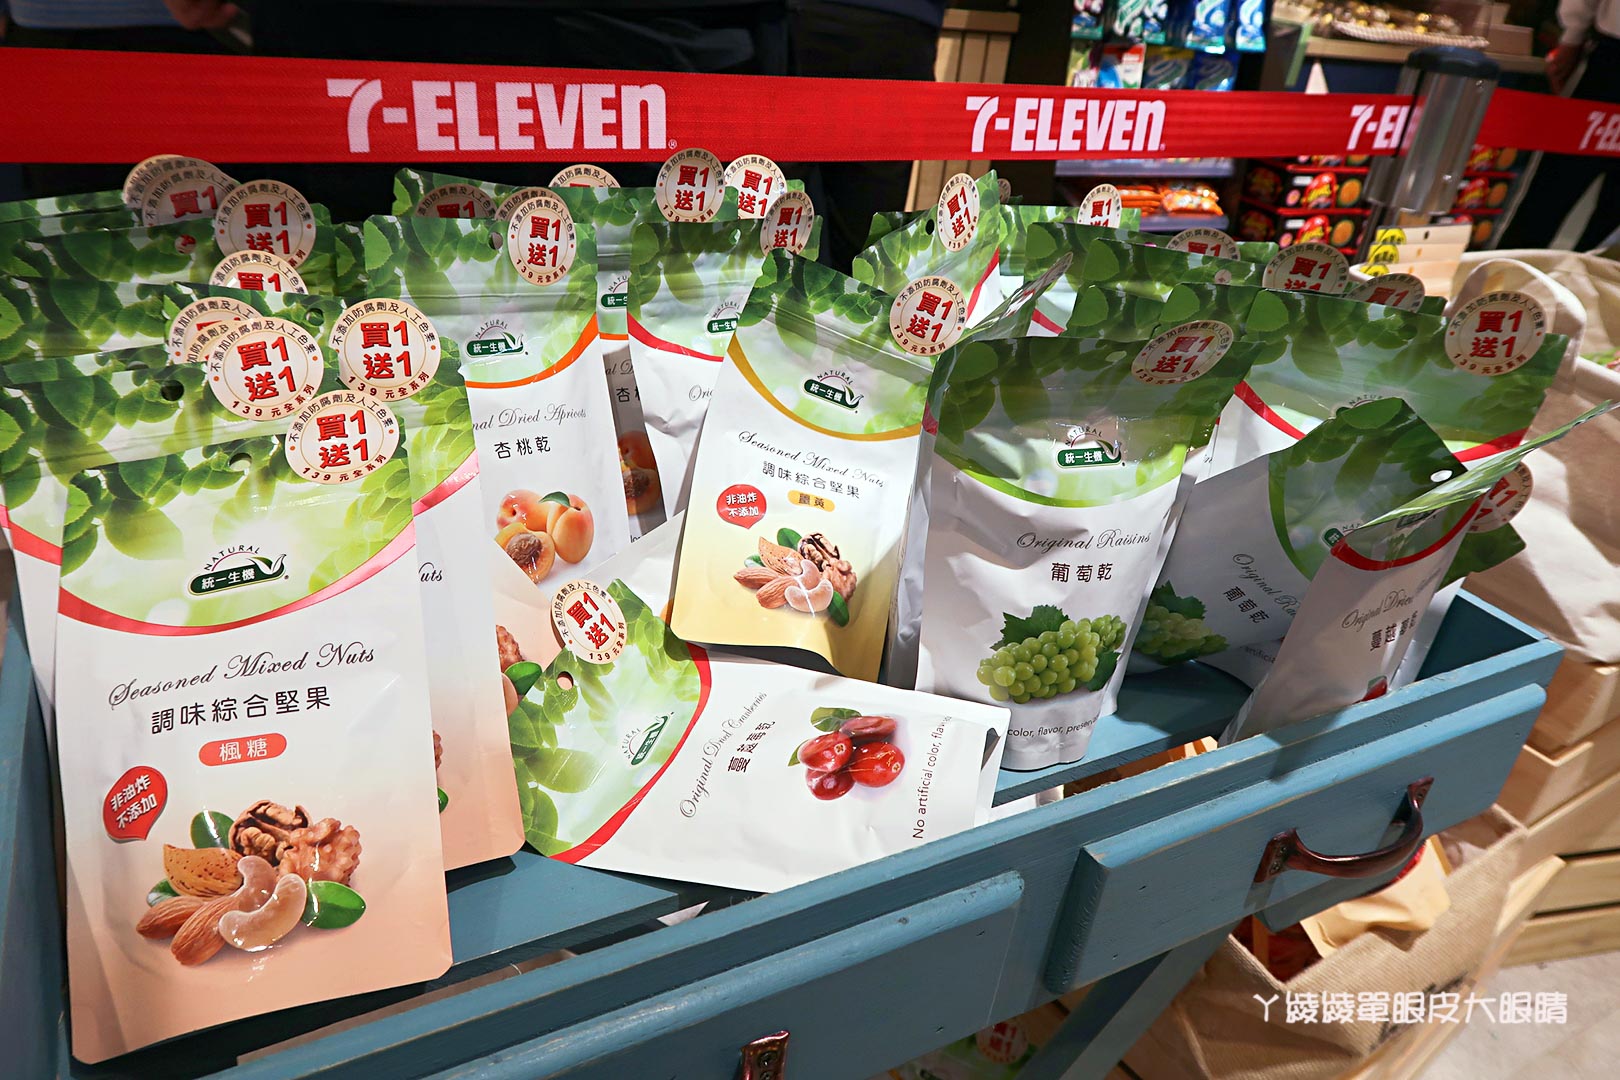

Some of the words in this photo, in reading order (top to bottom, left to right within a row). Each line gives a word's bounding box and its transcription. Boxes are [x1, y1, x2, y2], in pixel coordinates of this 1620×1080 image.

[677, 165, 710, 187] 買1
[741, 169, 774, 196] 買1
[169, 185, 218, 219] 買1
[673, 189, 707, 211] 送1
[738, 191, 769, 217] 送1
[946, 186, 968, 220] 買1
[1090, 198, 1113, 219] 買1
[243, 201, 288, 229] 買1
[777, 206, 803, 226] 買1
[951, 206, 971, 239] 送1
[529, 215, 562, 242] 買1
[773, 228, 798, 248] 送1
[246, 230, 292, 255] 送1
[527, 242, 559, 268] 送1
[1289, 256, 1332, 280] 買1
[915, 291, 955, 321] 買1
[360, 320, 410, 350] 買1
[905, 313, 945, 343] 送1
[1474, 310, 1524, 334] 買1
[237, 336, 290, 371] 買1
[1165, 335, 1216, 353] 買1
[1469, 336, 1518, 359] 送1
[362, 351, 413, 381] 送1
[1151, 354, 1199, 374] 送1
[245, 366, 298, 402] 送1
[816, 370, 854, 385] NATURAL
[316, 410, 368, 441] 買1
[498, 407, 540, 428] Dried
[318, 438, 371, 470] 送1
[494, 435, 552, 460] 杏桃乾
[738, 430, 802, 462] Seasoned
[802, 451, 849, 477] Mixed
[851, 468, 886, 488] Nuts
[762, 460, 860, 500] 調味綜合堅果
[726, 492, 758, 505] 非油炸
[728, 506, 760, 518] 不添加
[1016, 531, 1094, 554] Original
[1096, 529, 1152, 549] Raisins
[204, 544, 260, 571] NATURAL
[201, 567, 256, 591] 統一生機
[1050, 562, 1114, 583] 葡萄乾
[566, 592, 599, 629] 買1
[584, 612, 616, 650] 送1
[108, 665, 218, 711] Seasoned
[223, 651, 310, 680] Mixed
[316, 641, 376, 669] Nuts
[150, 685, 332, 736] 調味綜合堅果
[218, 737, 268, 763] 楓糖
[927, 741, 942, 767] color,
[109, 774, 152, 813] 非油炸
[917, 769, 933, 815] artificial
[116, 793, 159, 830] 不添加
[913, 819, 926, 839] No
